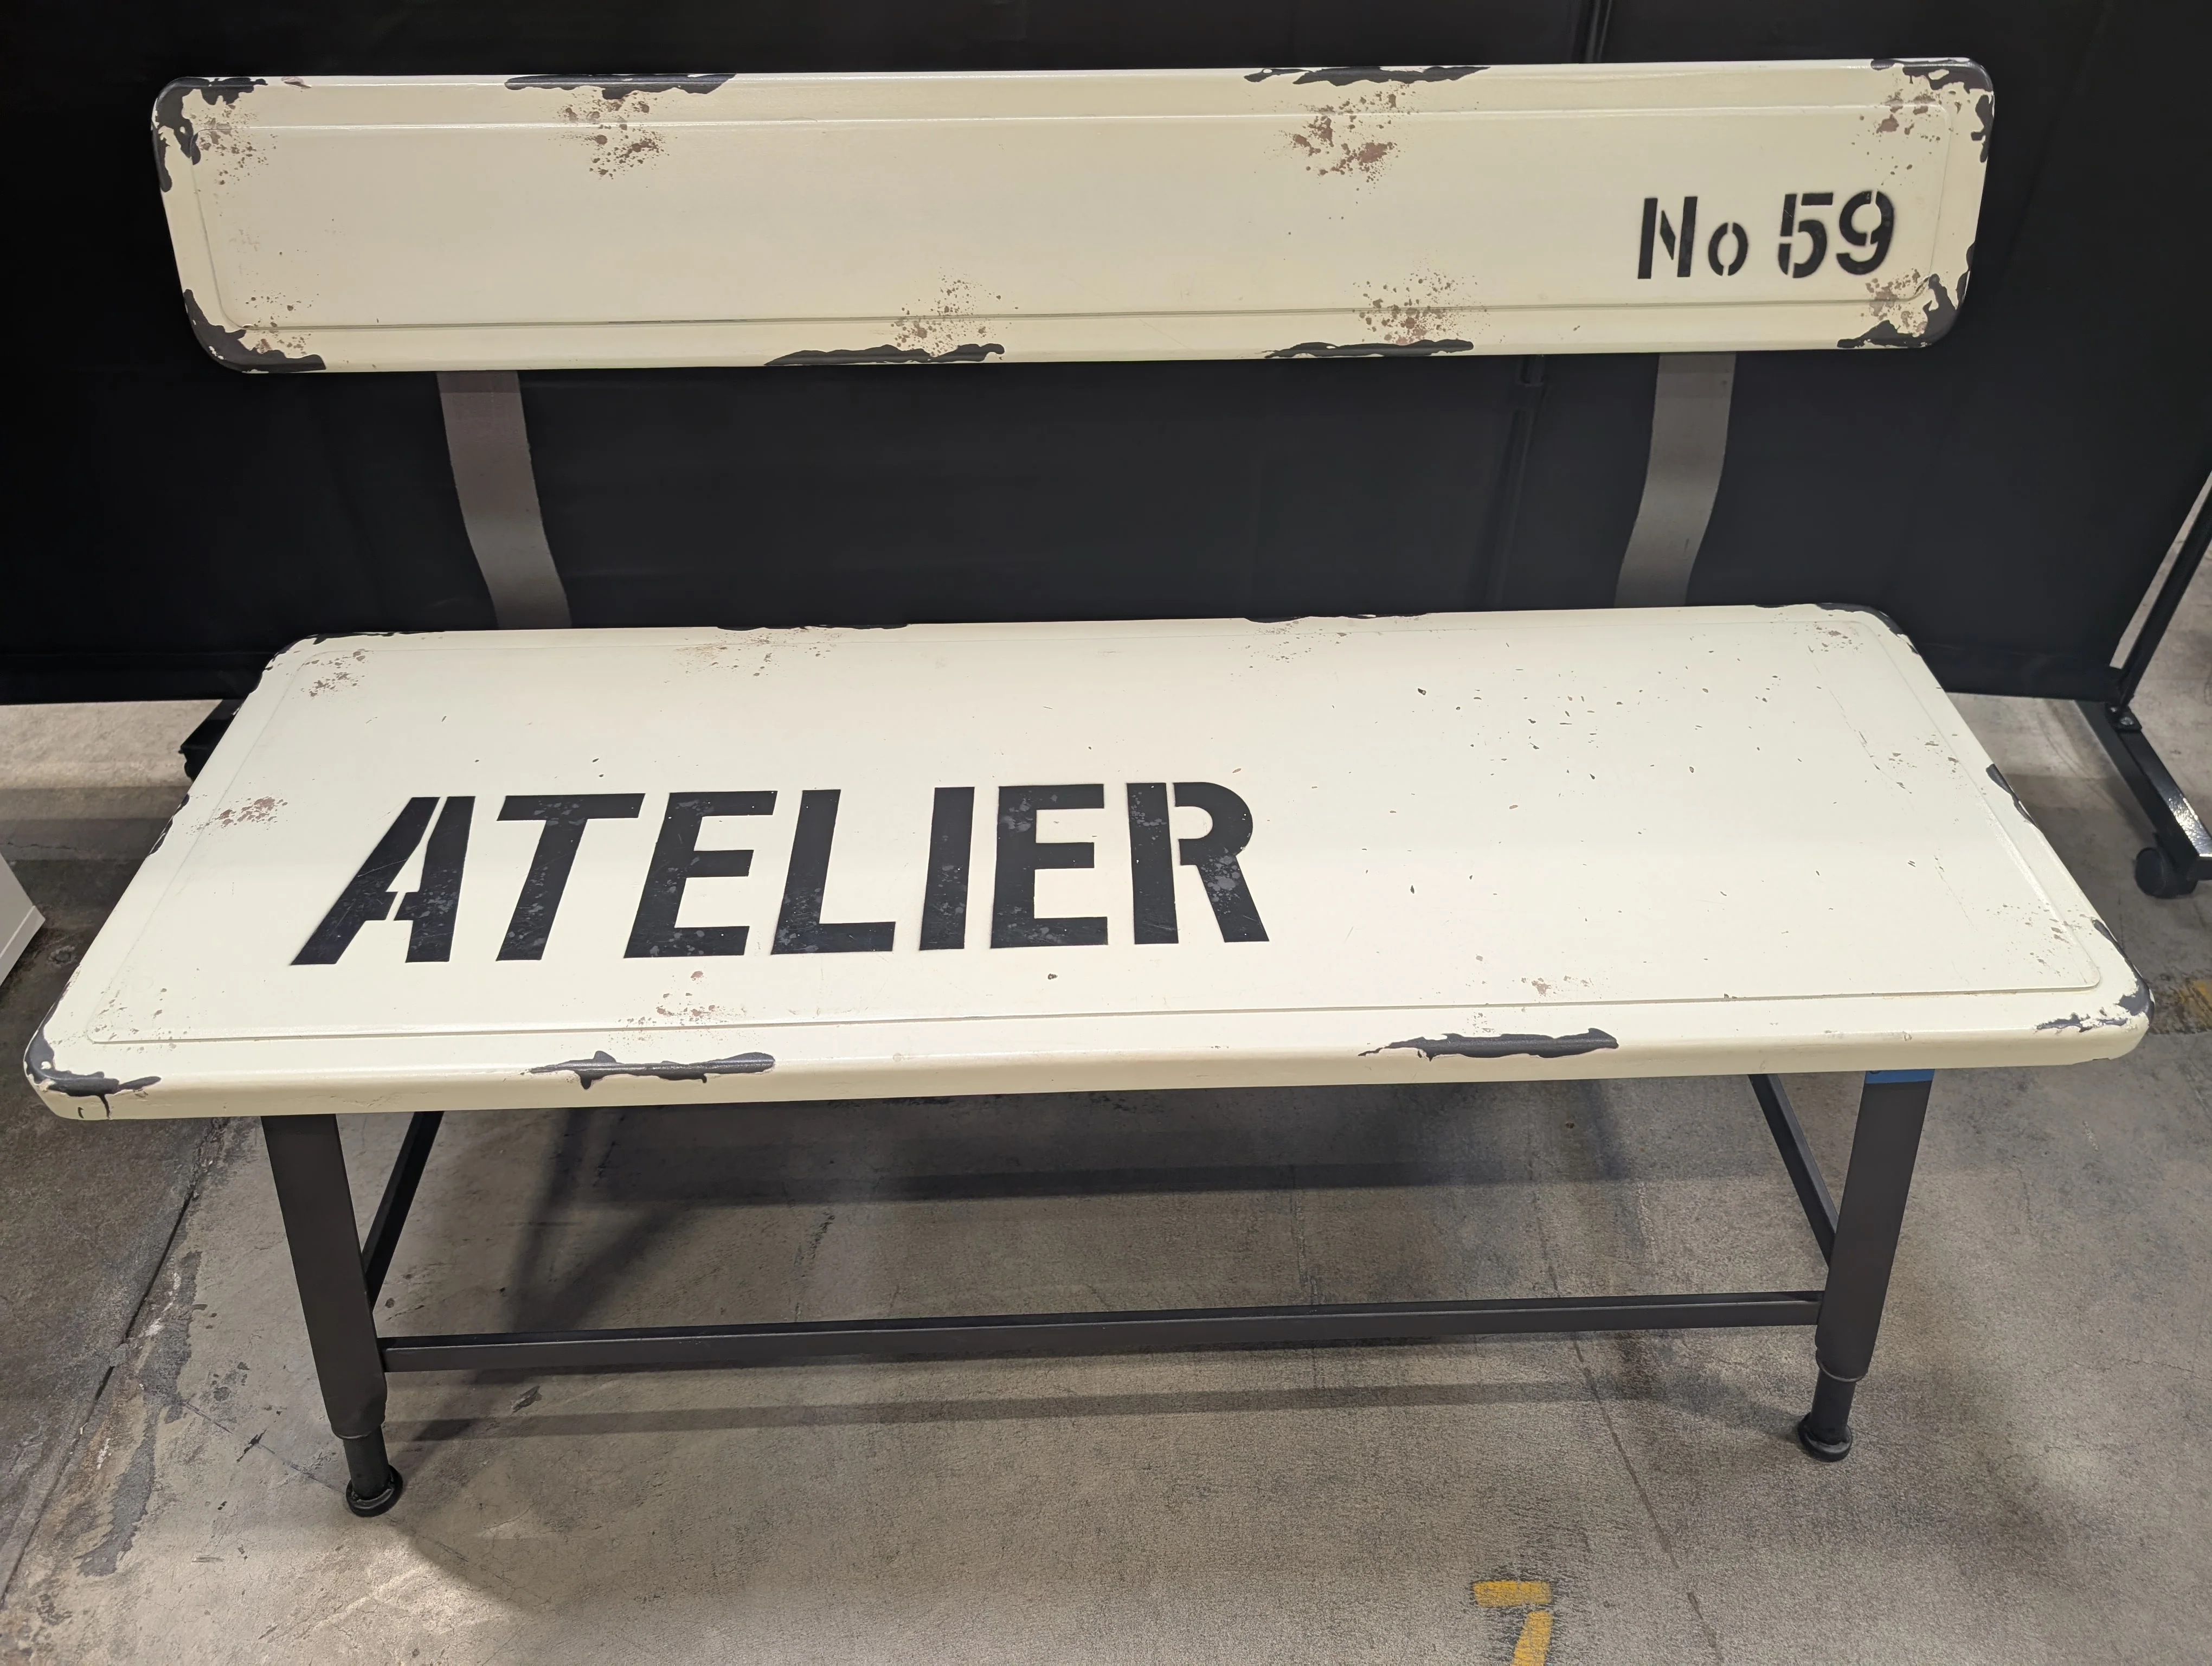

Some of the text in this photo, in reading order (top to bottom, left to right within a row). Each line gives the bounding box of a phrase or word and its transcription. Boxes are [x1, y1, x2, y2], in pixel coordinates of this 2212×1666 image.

[1637, 190, 1895, 279] No 59
[291, 781, 1270, 966] ATELIER
